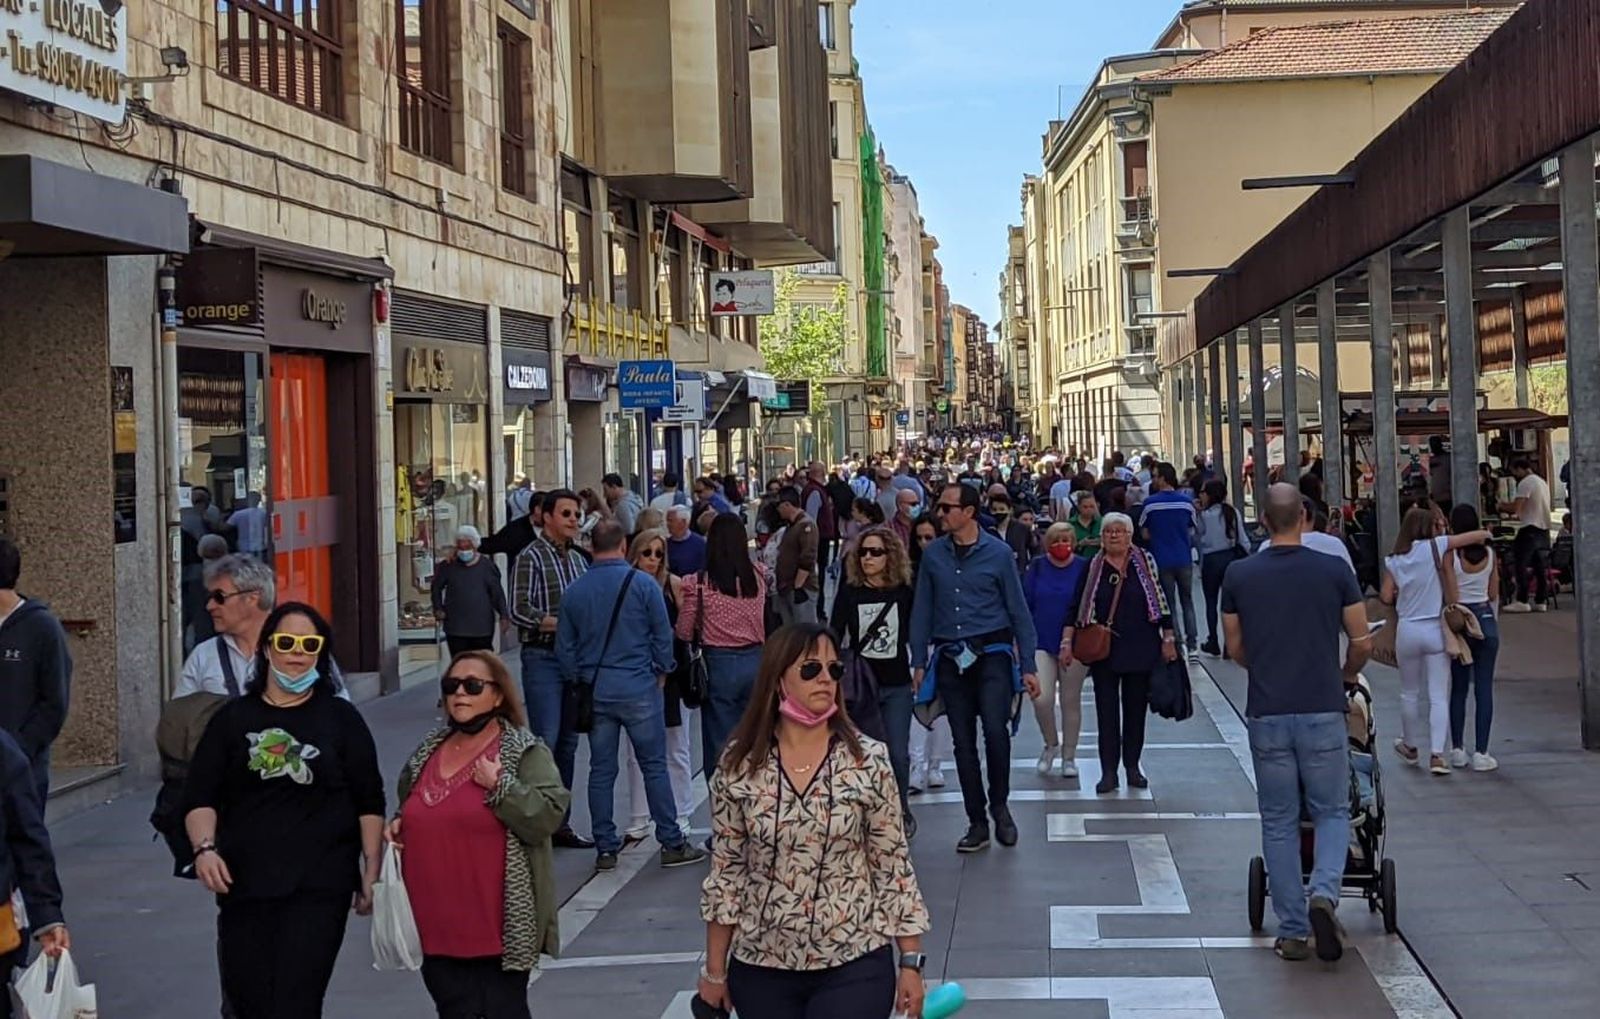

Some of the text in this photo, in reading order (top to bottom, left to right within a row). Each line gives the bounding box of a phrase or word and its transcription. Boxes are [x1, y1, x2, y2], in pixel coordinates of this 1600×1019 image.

[47, 0, 118, 51] LOCALES
[186, 303, 250, 320] orange
[305, 289, 347, 329] Orange
[507, 364, 548, 390] CALZEDONIA
[622, 364, 671, 384] Paula
